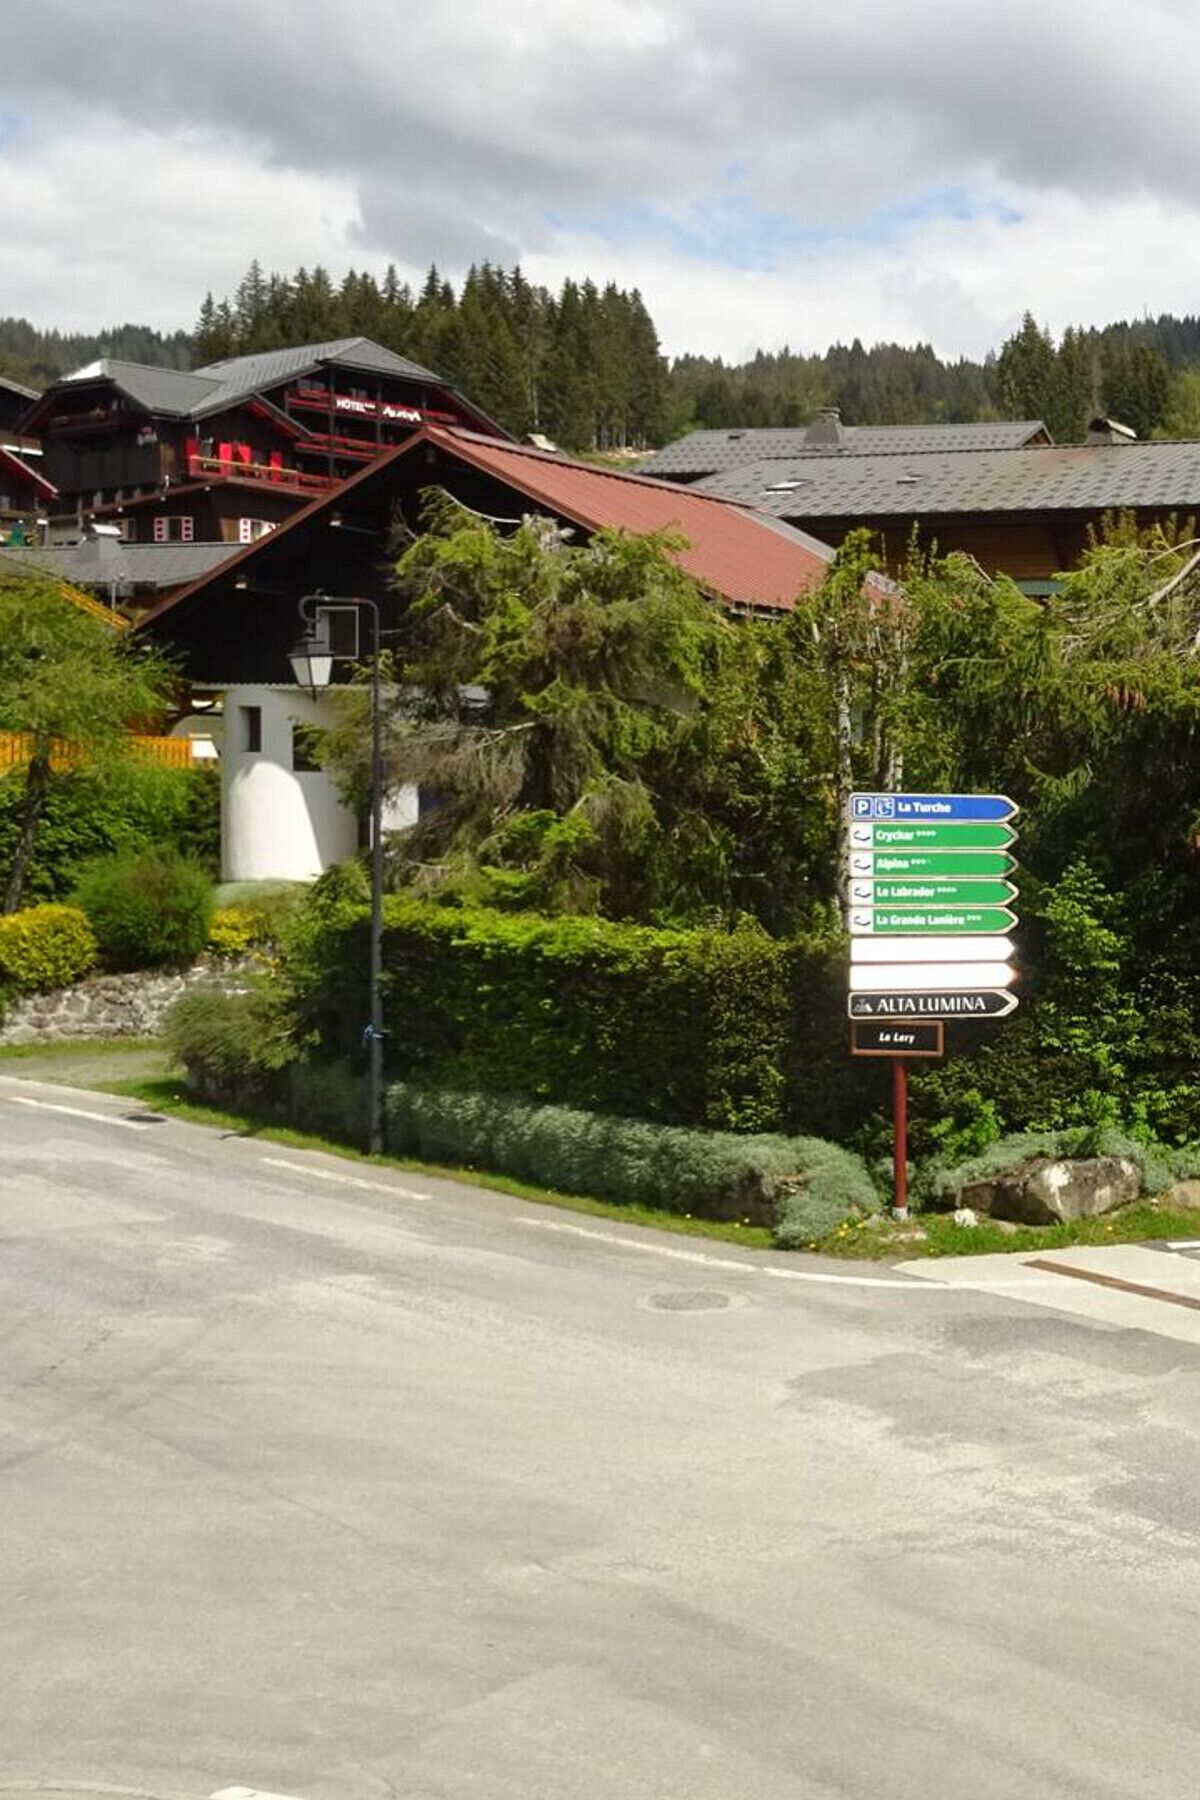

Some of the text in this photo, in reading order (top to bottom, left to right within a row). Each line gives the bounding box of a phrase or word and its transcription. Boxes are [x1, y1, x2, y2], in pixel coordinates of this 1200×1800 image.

[898, 802, 951, 813] La Turche
[876, 831, 914, 842] Crychar
[876, 858, 910, 871] Alpina
[891, 887, 935, 897] Labrador
[890, 914, 926, 925] Grande
[877, 997, 986, 1012] ALTA LUMINA
